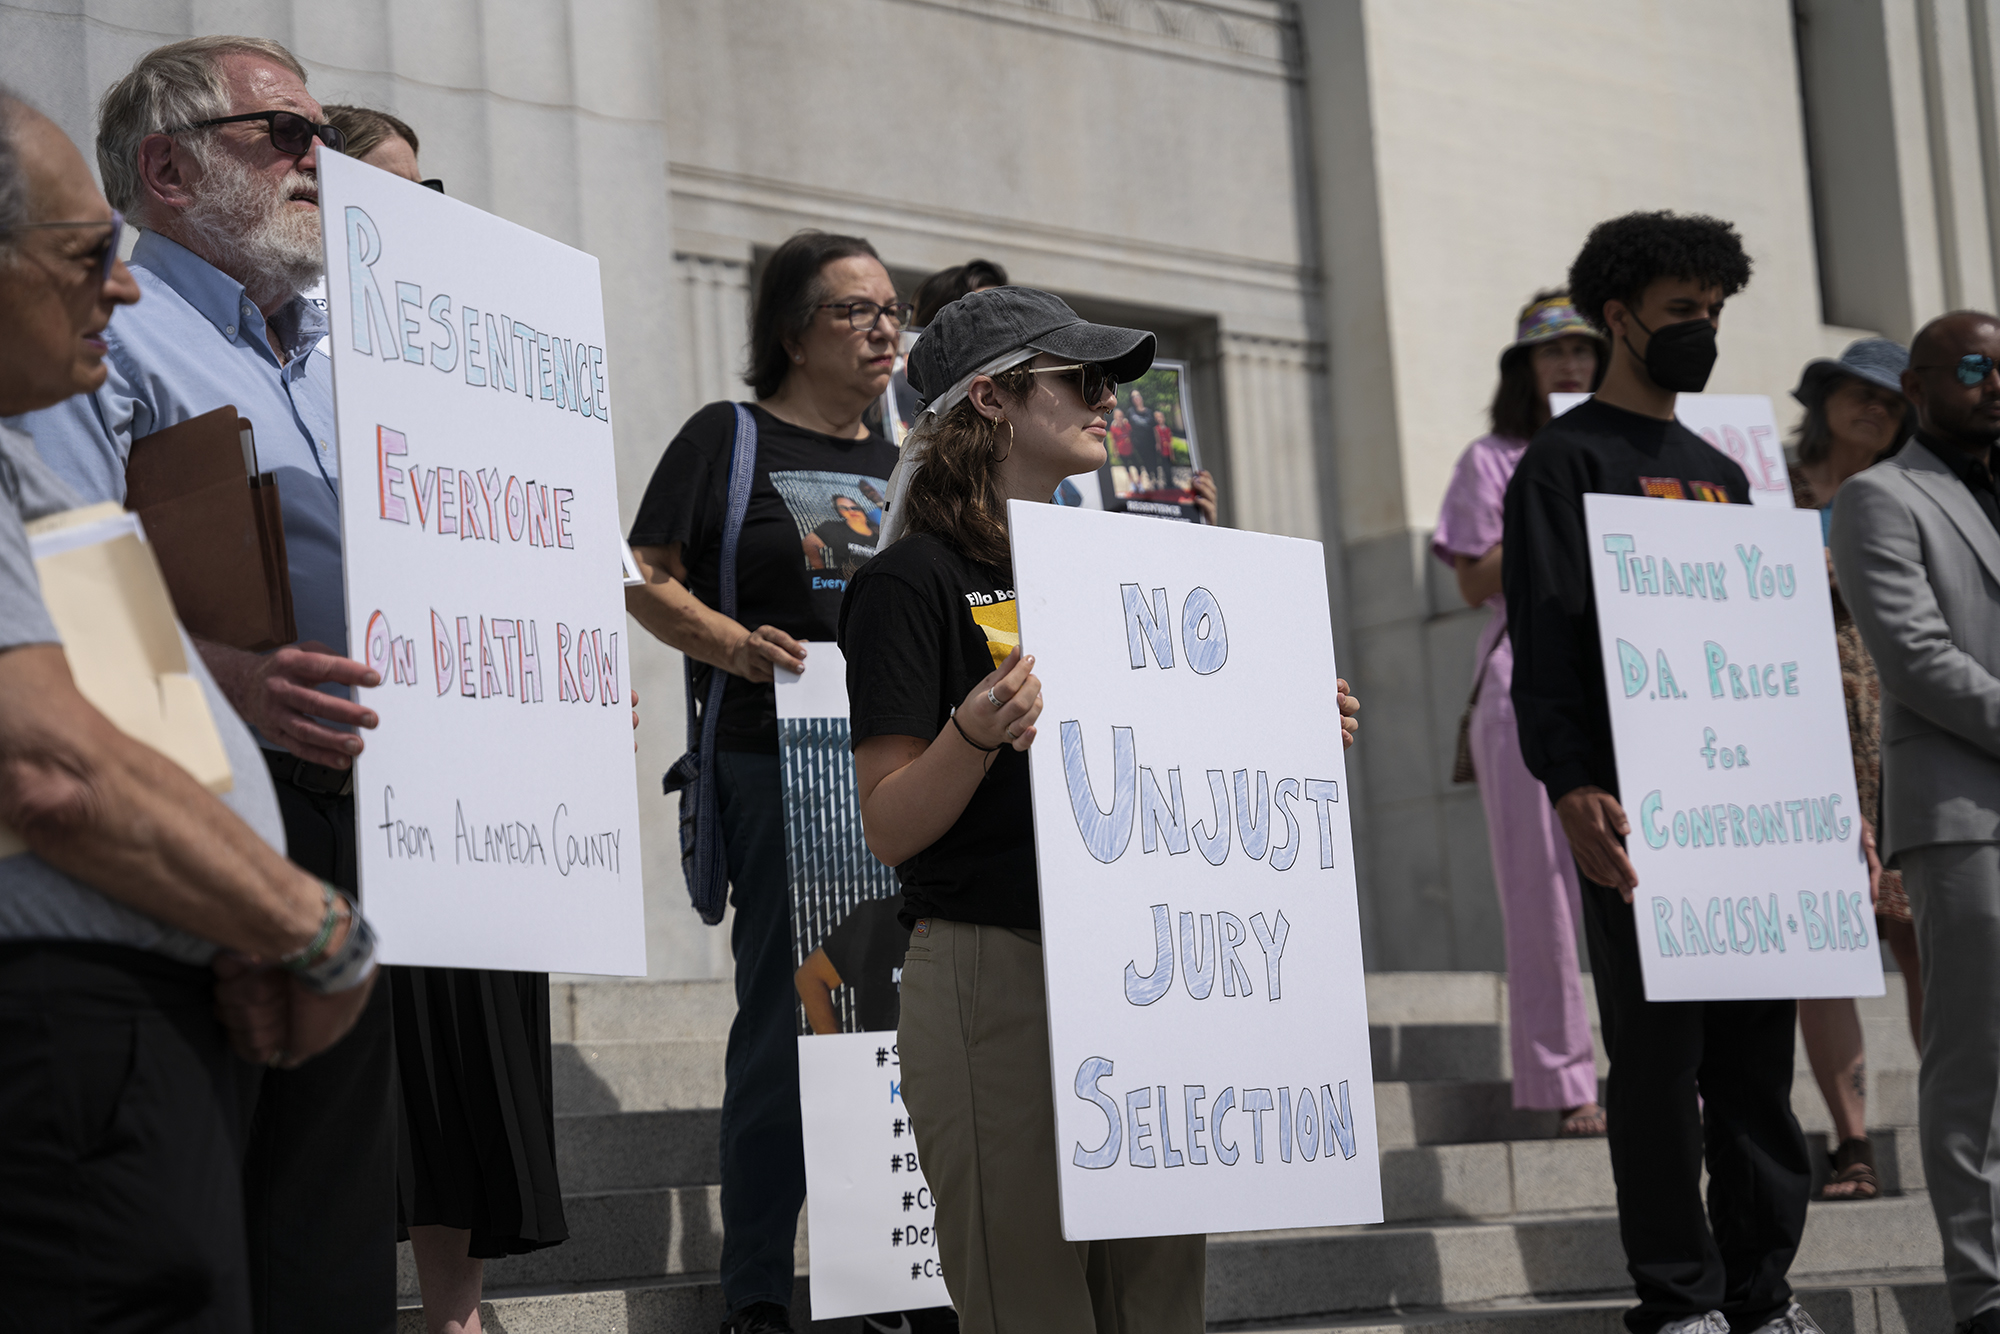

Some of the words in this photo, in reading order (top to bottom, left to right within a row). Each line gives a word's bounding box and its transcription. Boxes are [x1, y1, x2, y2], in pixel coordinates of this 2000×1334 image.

[344, 205, 609, 424] RESENTENCE
[376, 424, 575, 549] EVERYONE
[965, 591, 993, 606] Ella
[1603, 533, 1727, 600] THANK
[1735, 543, 1796, 600] YOU
[430, 606, 543, 704] DEATH
[557, 622, 620, 707] ROW
[1120, 582, 1228, 675] NO
[1616, 637, 1688, 701] D.A.
[1704, 640, 1800, 699] PRICE
[455, 798, 546, 865] ALAMEDA
[552, 803, 621, 878] COUNTY
[1060, 718, 1339, 871] UNJUST
[1641, 789, 1851, 850] CONFRONTING
[1124, 903, 1290, 1006] JURY
[1651, 893, 1787, 957] RACISM
[1798, 889, 1869, 951] BIAS
[1072, 1056, 1357, 1170] SELECTION
